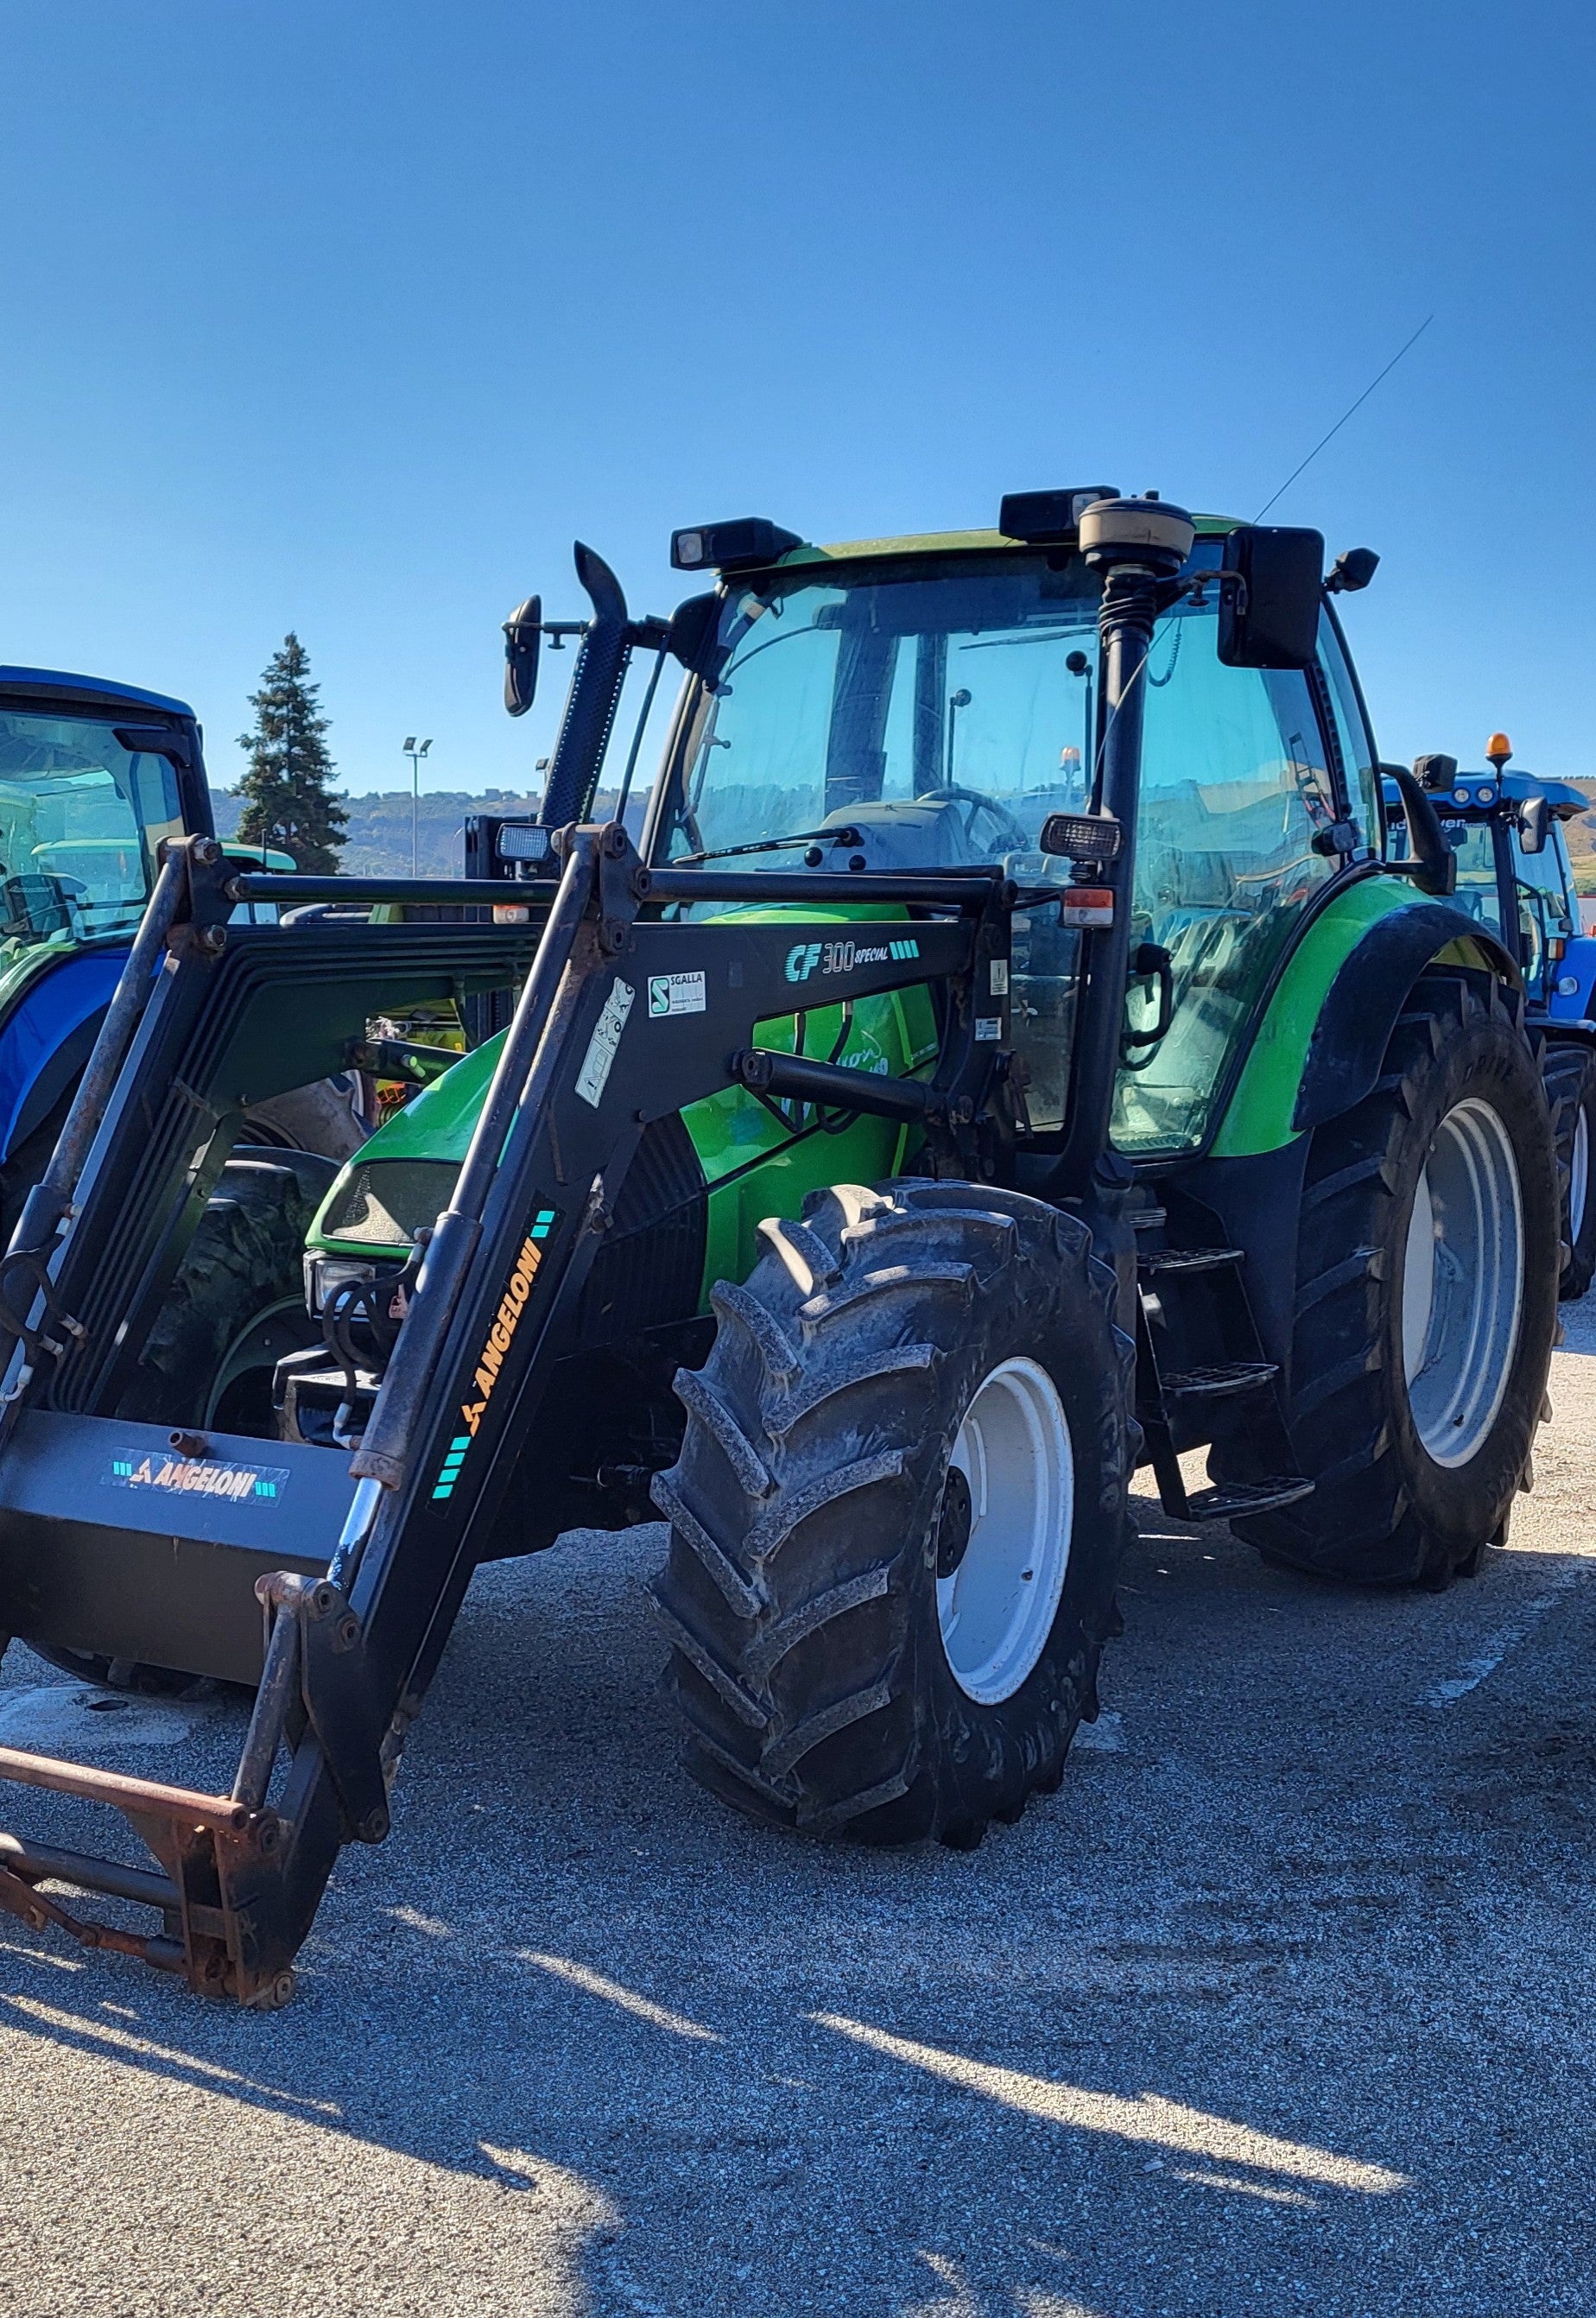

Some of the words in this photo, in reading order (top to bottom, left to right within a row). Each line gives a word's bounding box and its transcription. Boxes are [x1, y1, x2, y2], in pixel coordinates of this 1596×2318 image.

[670, 973, 702, 985] SGALLA
[784, 944, 822, 982] CF
[822, 941, 855, 974] 300
[854, 947, 889, 964] SPECIAL
[475, 1237, 542, 1399] ANGELONI
[153, 1461, 257, 1498] ANGELONI
